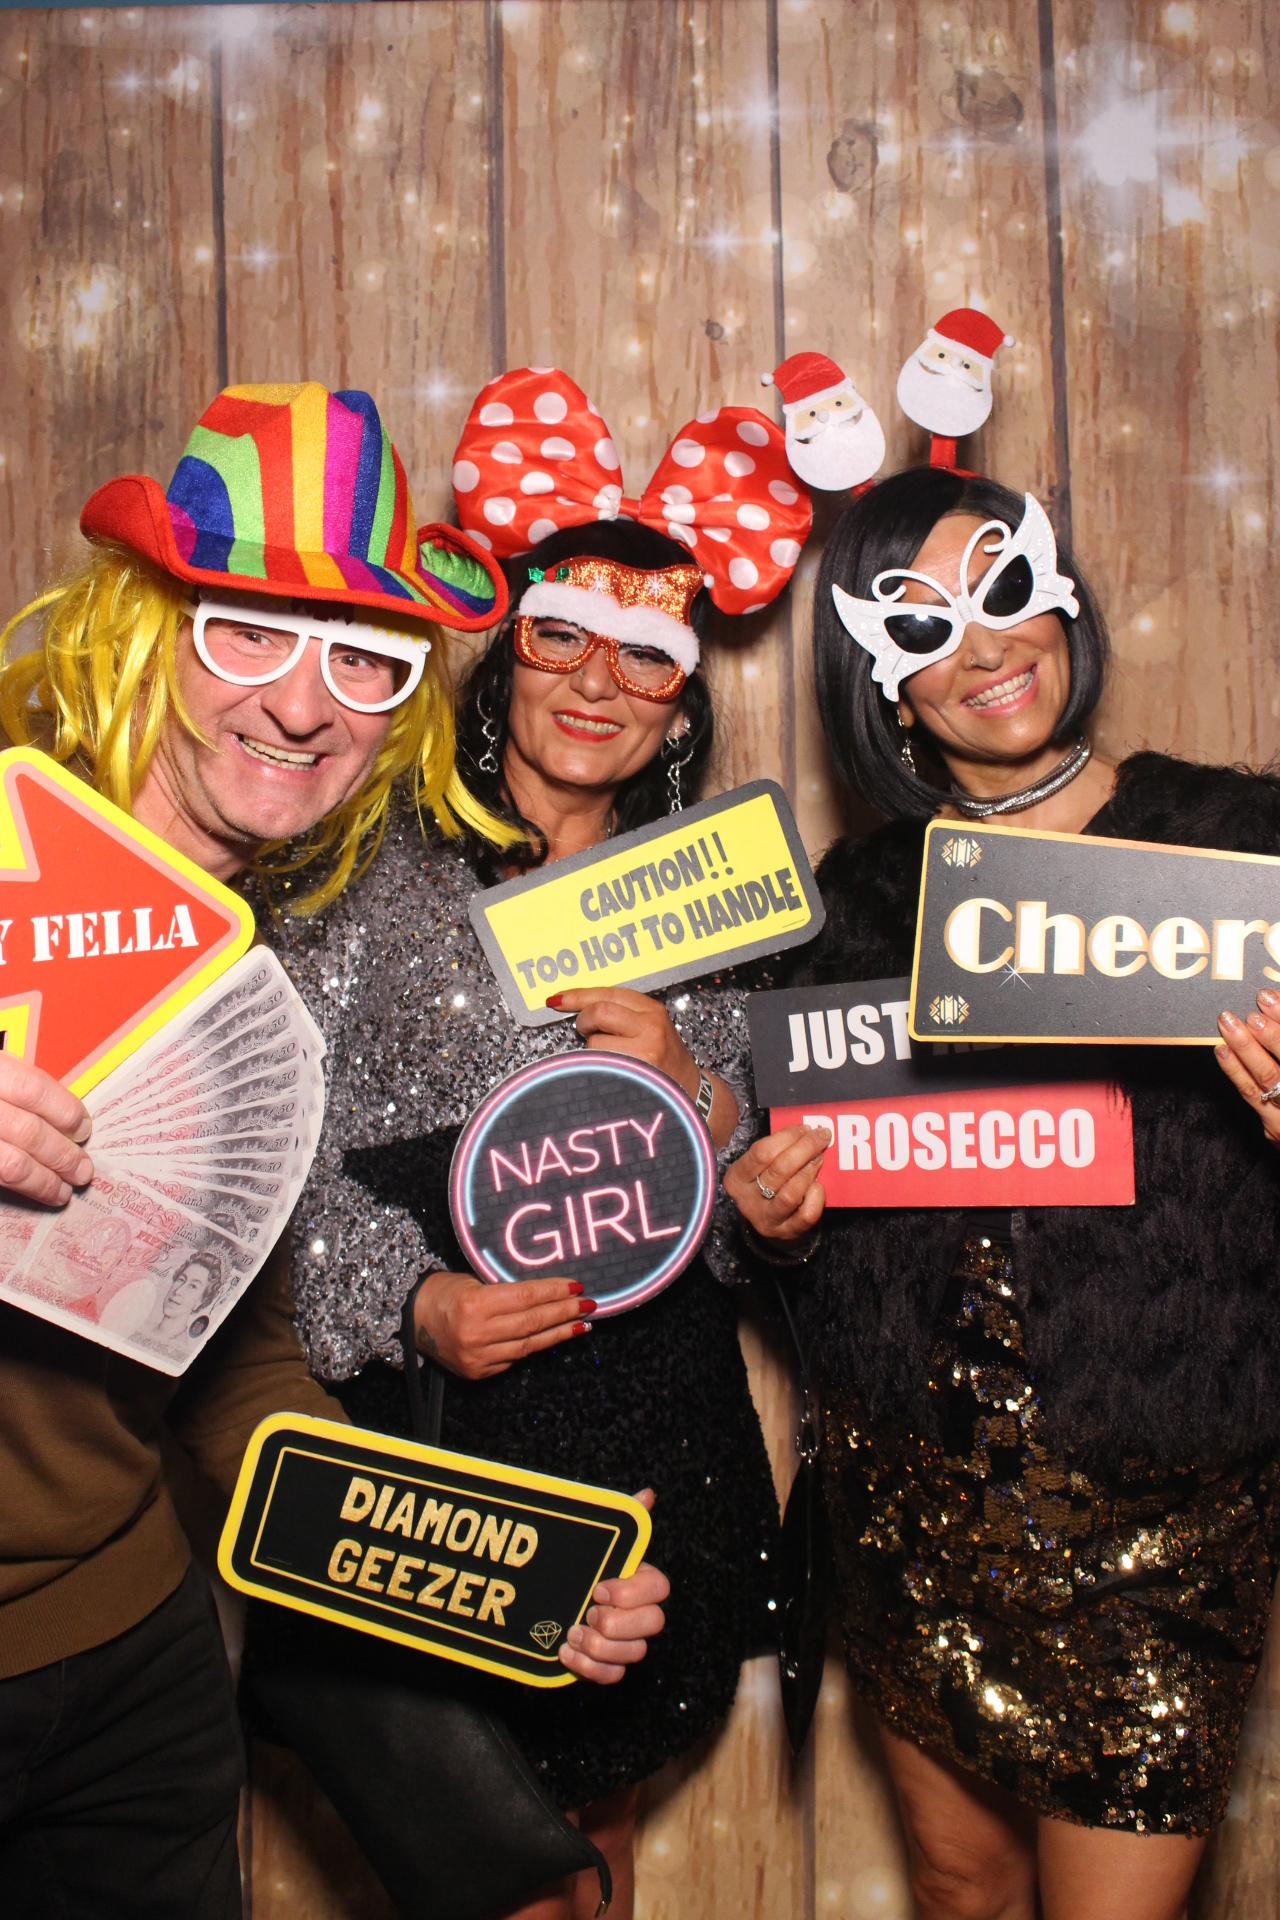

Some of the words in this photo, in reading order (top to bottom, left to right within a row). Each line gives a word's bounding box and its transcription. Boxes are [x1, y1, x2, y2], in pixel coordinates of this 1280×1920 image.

[580, 832, 734, 921] CAUTION!!
[32, 904, 199, 962] FELLA
[516, 948, 579, 989] TOO
[579, 921, 640, 972] HOT
[642, 912, 684, 950] TO
[684, 867, 802, 940] HANDLE
[788, 1001, 912, 1073] JUST
[490, 1112, 663, 1192] NASTY
[505, 1180, 682, 1265] GIRL
[340, 1476, 539, 1568] DIAMOND
[328, 1538, 516, 1626] GEEZER
